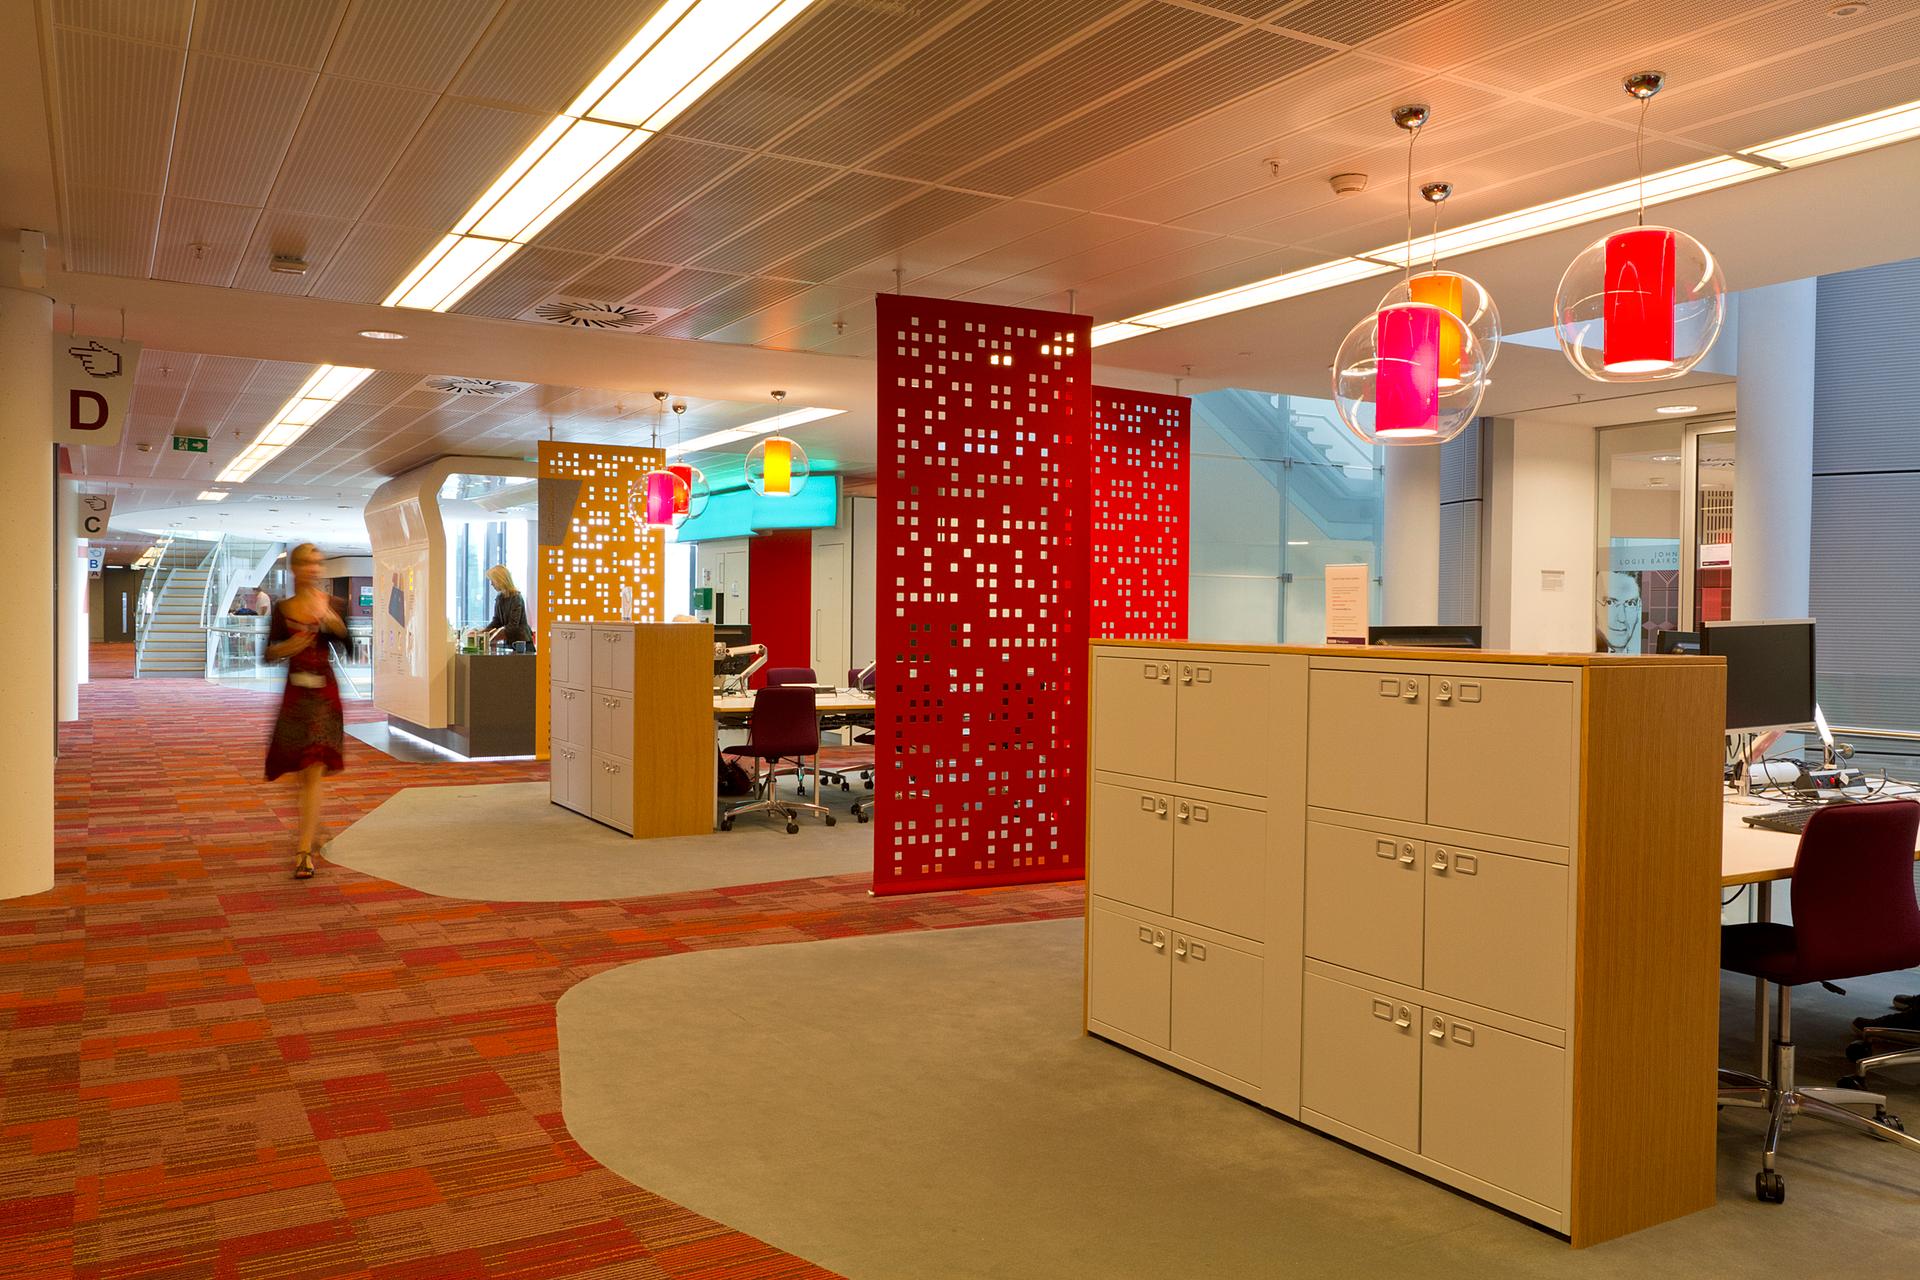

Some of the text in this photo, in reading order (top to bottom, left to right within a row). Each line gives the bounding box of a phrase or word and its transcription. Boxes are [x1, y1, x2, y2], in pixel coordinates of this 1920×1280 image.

[70, 389, 109, 430] D
[84, 516, 101, 533] C
[89, 559, 99, 569] B
